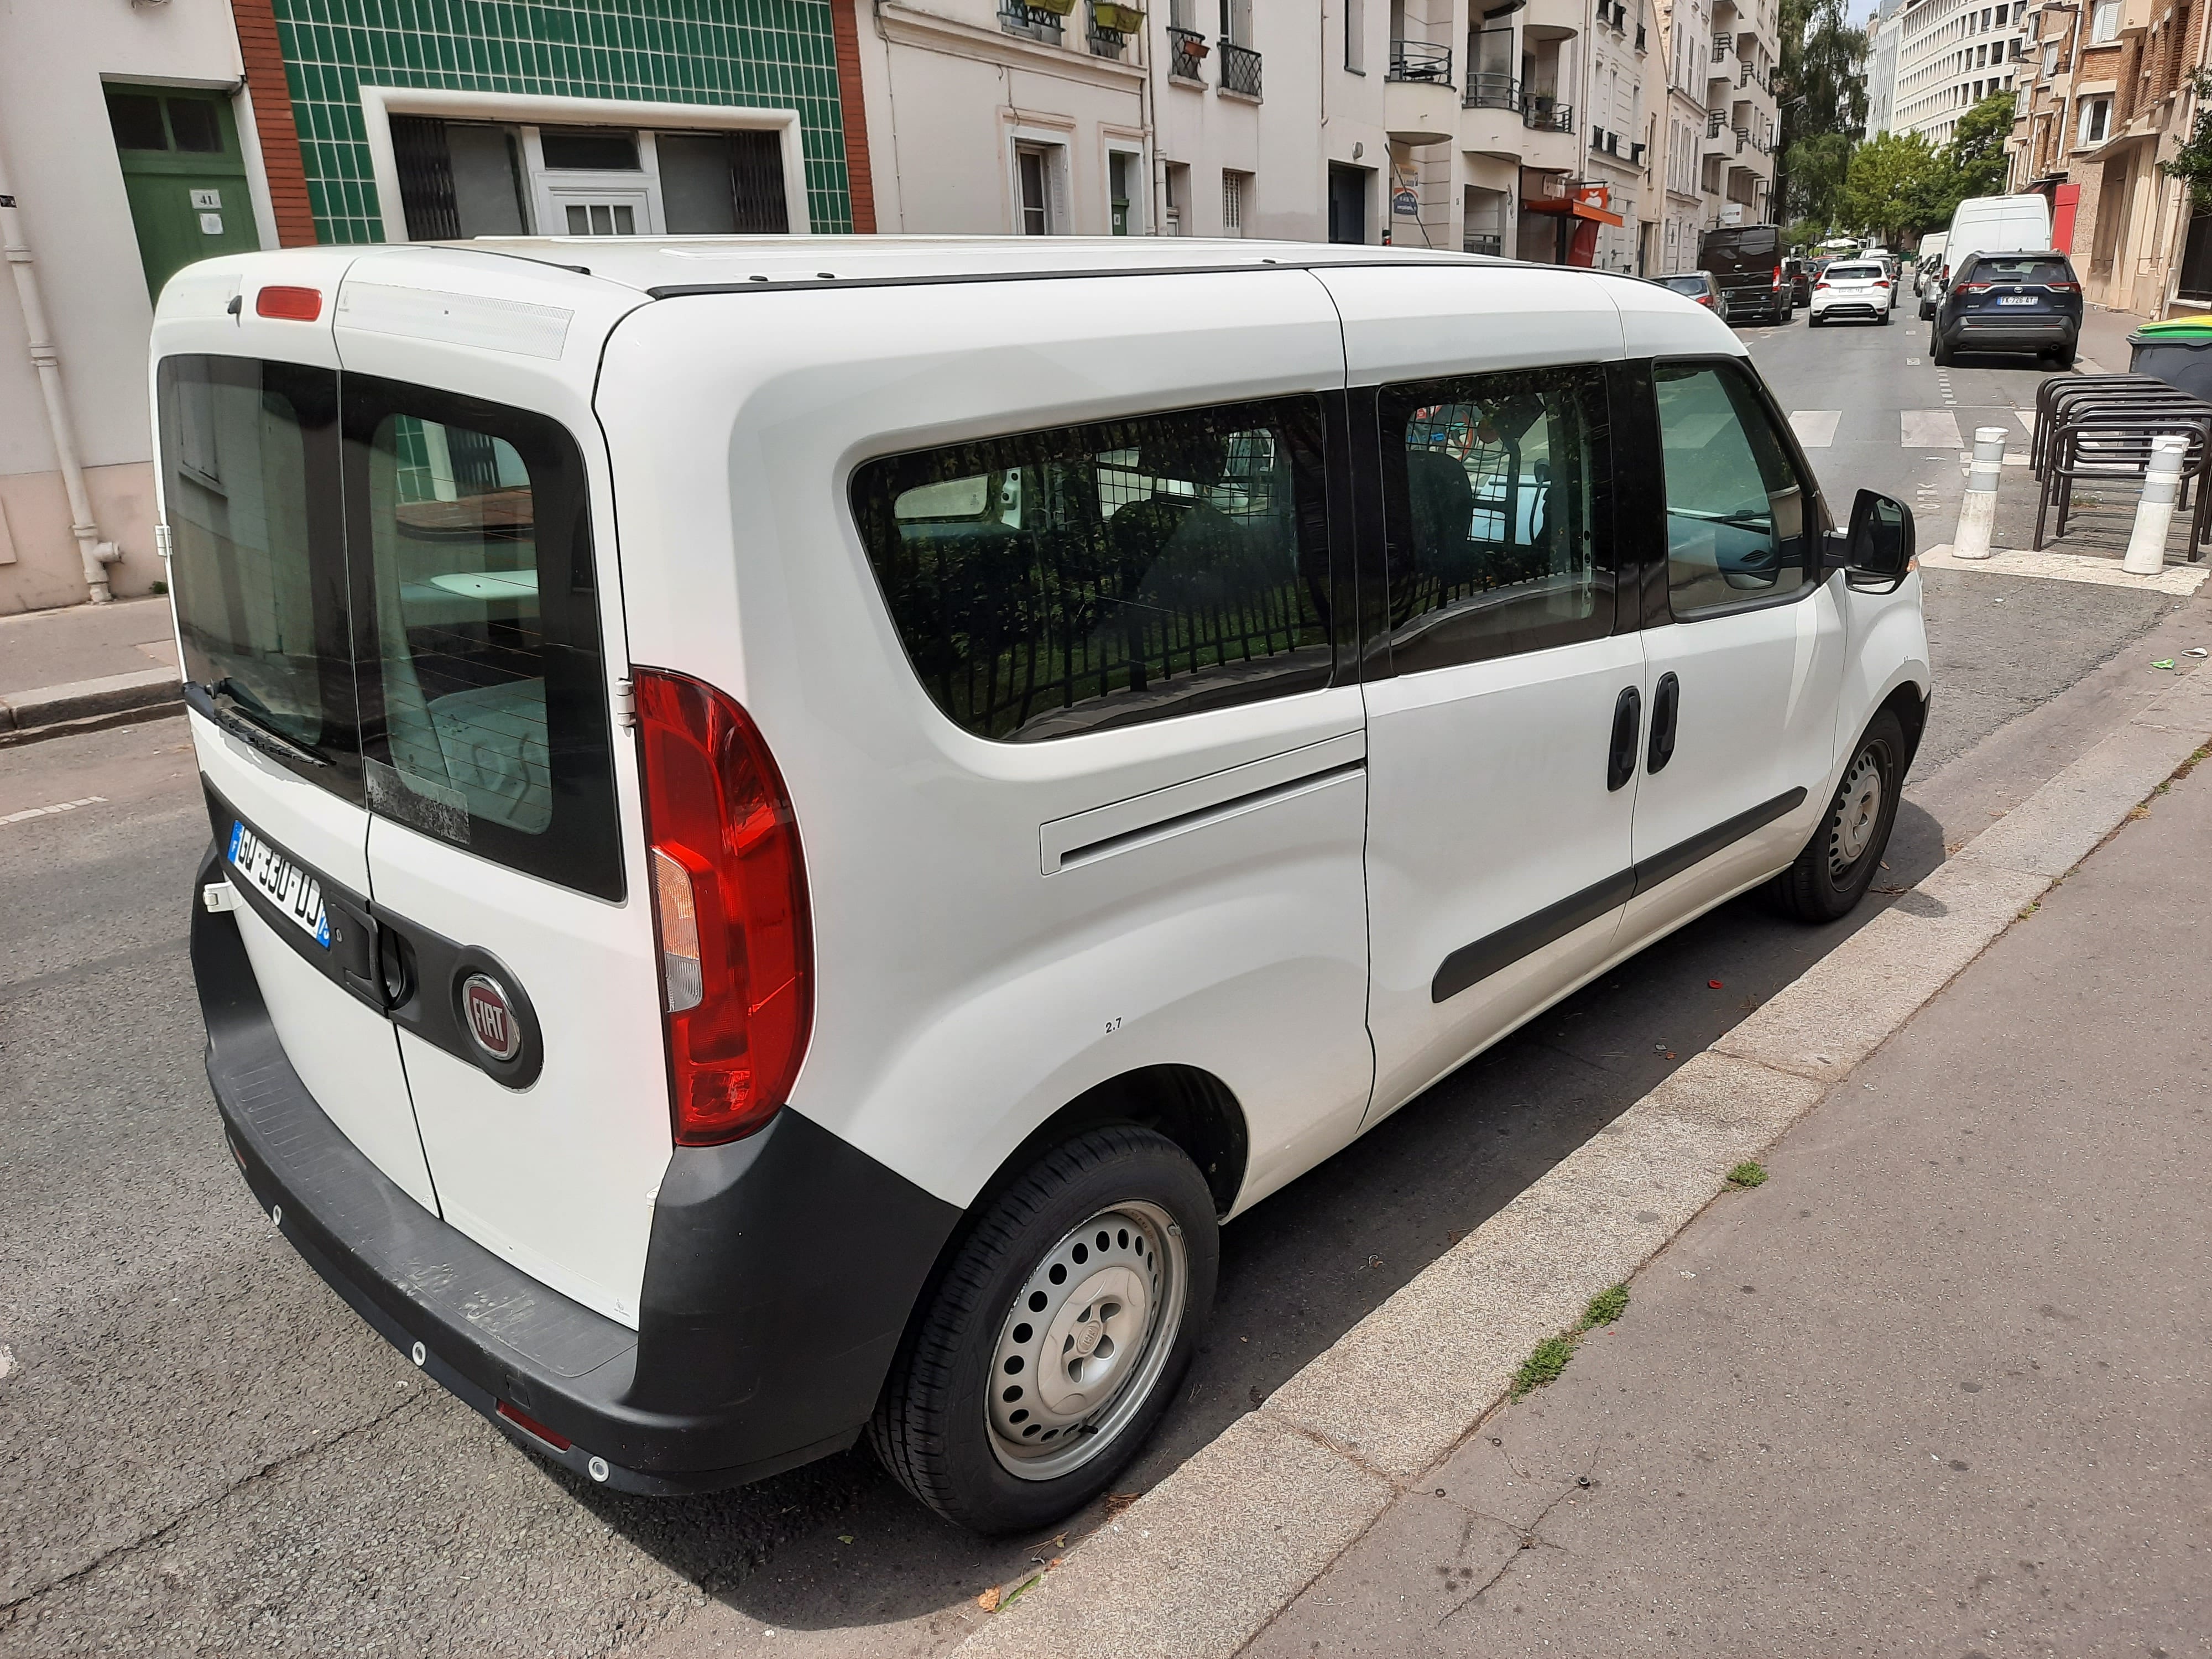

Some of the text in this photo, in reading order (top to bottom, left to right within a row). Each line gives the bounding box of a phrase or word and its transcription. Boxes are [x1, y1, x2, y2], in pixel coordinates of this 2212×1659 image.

[200, 195, 213, 205] 41
[472, 997, 504, 1042] FIAT
[1105, 1017, 1122, 1034] 2.7
